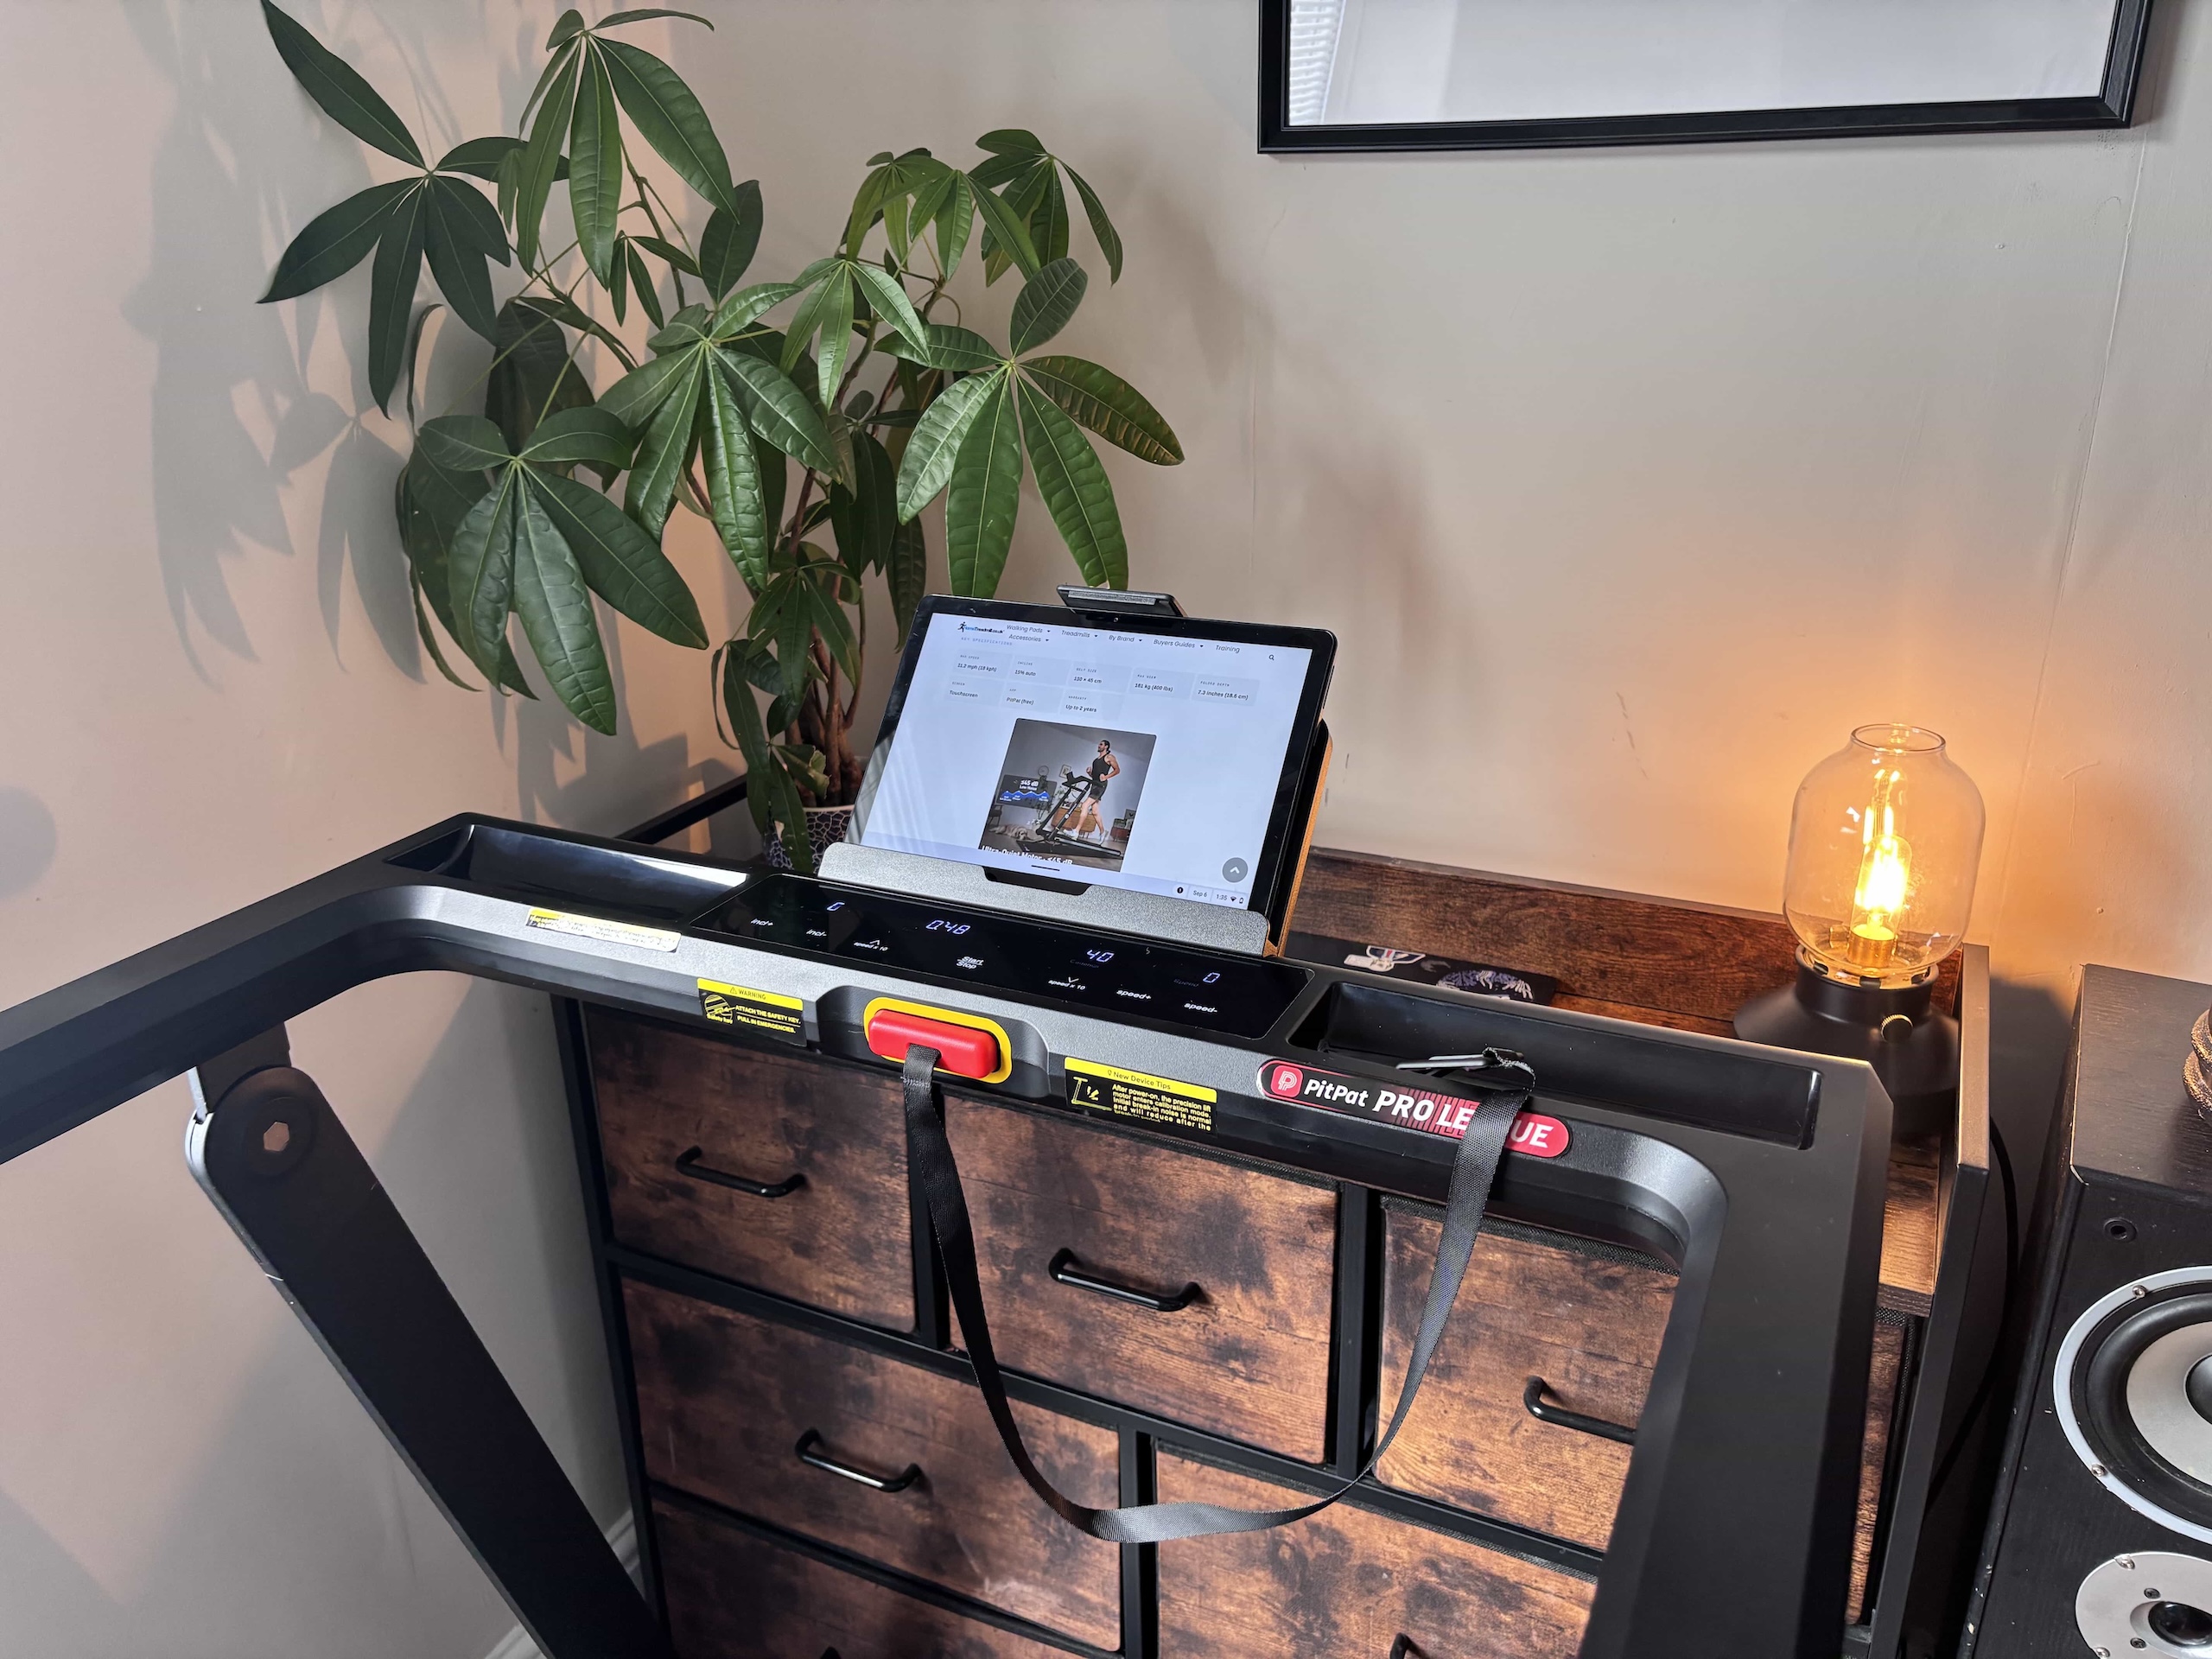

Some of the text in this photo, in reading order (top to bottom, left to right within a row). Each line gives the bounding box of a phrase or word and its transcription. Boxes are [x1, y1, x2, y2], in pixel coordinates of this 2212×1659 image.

[1216, 645, 1240, 653] Training
[949, 690, 978, 698] Touchscreen
[1087, 950, 1115, 963] 40
[1203, 972, 1220, 983] 0
[738, 988, 766, 1000] WARNING
[1116, 989, 1152, 1000] speed+
[735, 1005, 756, 1014] ATTACH
[767, 1011, 787, 1021] SAFETY
[1184, 1003, 1217, 1013] speed-
[737, 1015, 751, 1024] PULL
[757, 1020, 796, 1033] EMERGENCIES.
[1114, 1071, 1171, 1090] New Device Tips
[1112, 1084, 1128, 1093] After
[1128, 1089, 1160, 1101] power-on,
[1173, 1097, 1202, 1110] precision
[1132, 1095, 1154, 1105] enters
[1154, 1099, 1189, 1114] calibration
[1190, 1109, 1211, 1118] mode.
[1132, 1101, 1160, 1112] break-in
[1160, 1108, 1179, 1117] noise
[1188, 1114, 1211, 1125] normal
[1304, 1079, 1554, 1148] PitPat PRO LEUE
[1131, 1106, 1144, 1116] will
[1147, 1111, 1173, 1122] reduce
[1176, 1117, 1195, 1128] after
[1198, 1122, 1211, 1131] the
